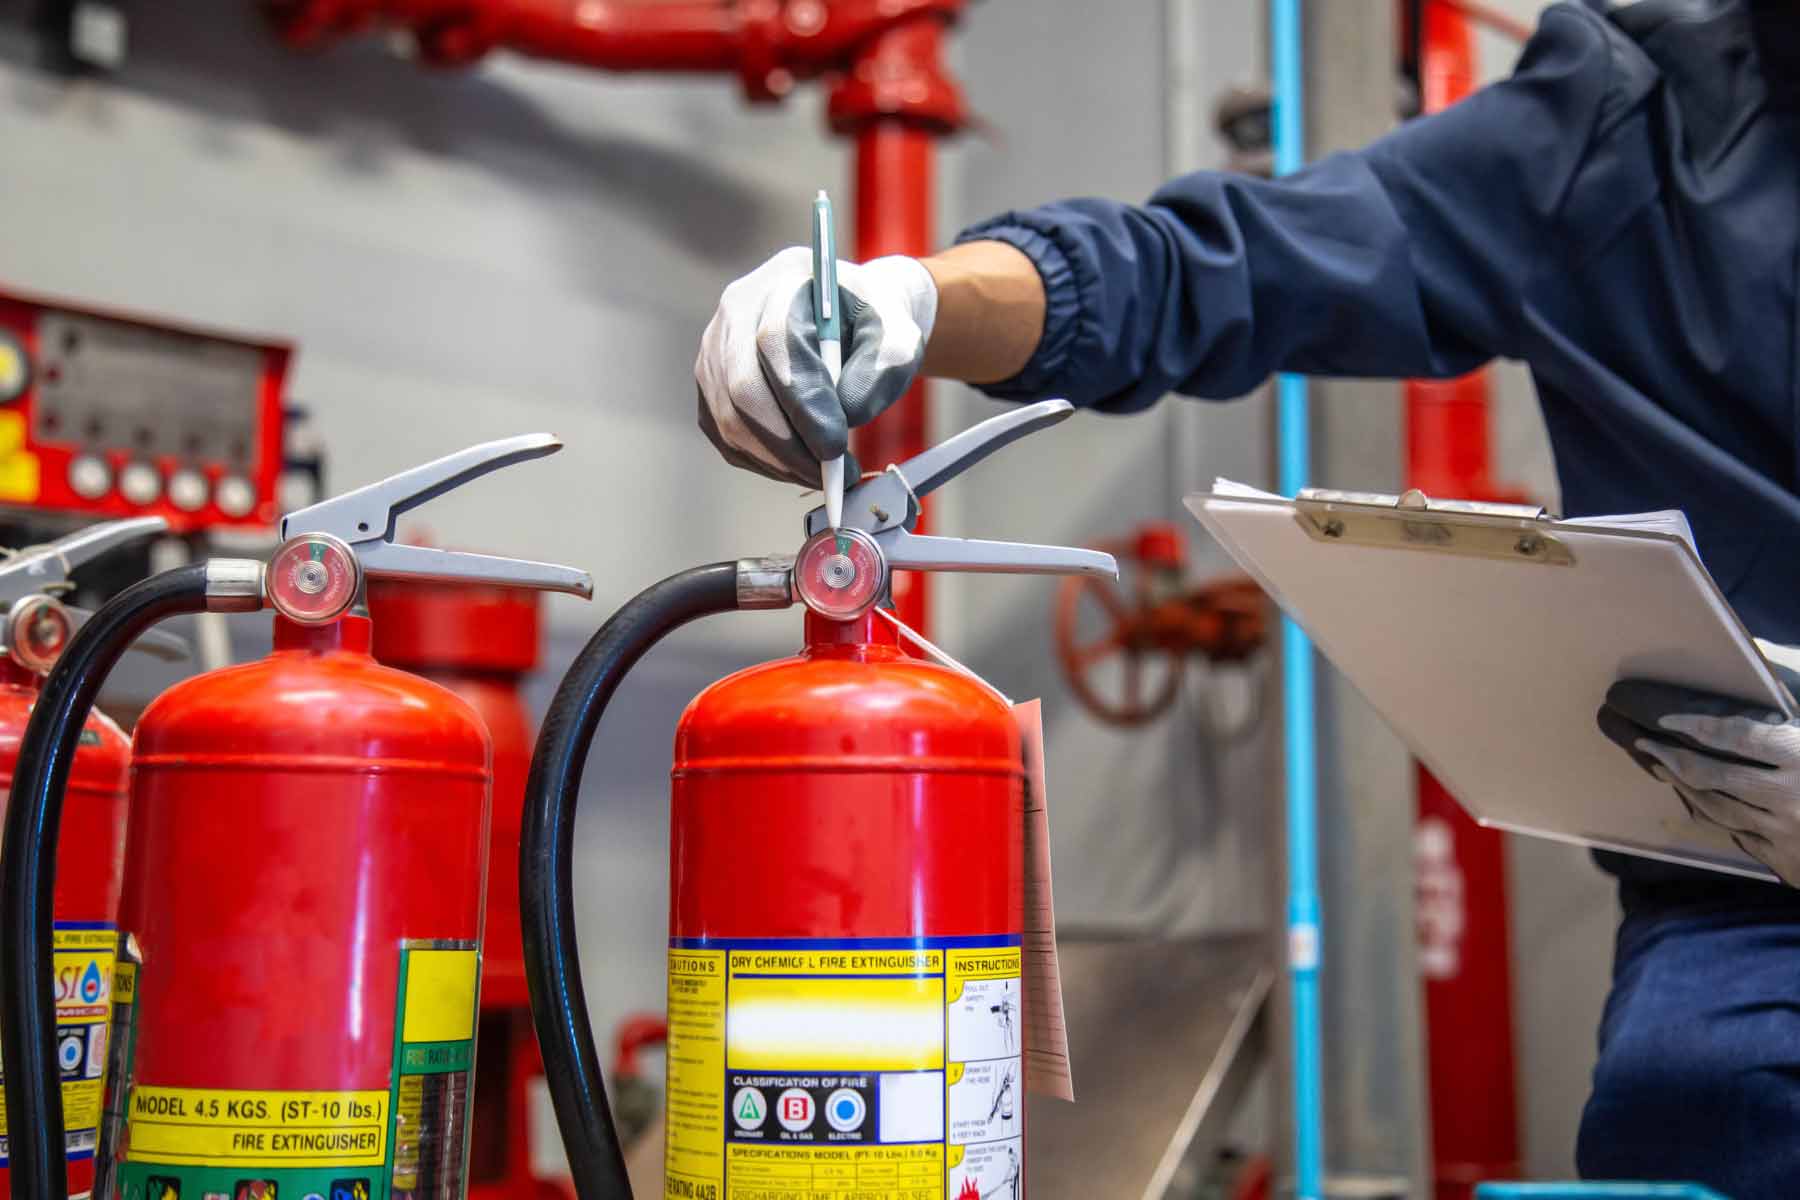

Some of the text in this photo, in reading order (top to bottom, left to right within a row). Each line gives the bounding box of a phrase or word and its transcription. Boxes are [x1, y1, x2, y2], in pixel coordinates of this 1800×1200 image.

[732, 956, 752, 968] DRY
[820, 956, 847, 969] FIRE
[851, 955, 940, 969] EXTINGUISHER
[733, 1076, 868, 1089] CLASSIFICATION OF FIRE
[136, 1096, 382, 1122] MODEL 4.5 KGS. (ST-10 lbs.)
[233, 1133, 376, 1151] FIRE EXTINGUISHER
[732, 1148, 811, 1160] SPECIFICATIONS
[814, 1151, 850, 1161] MODEL
